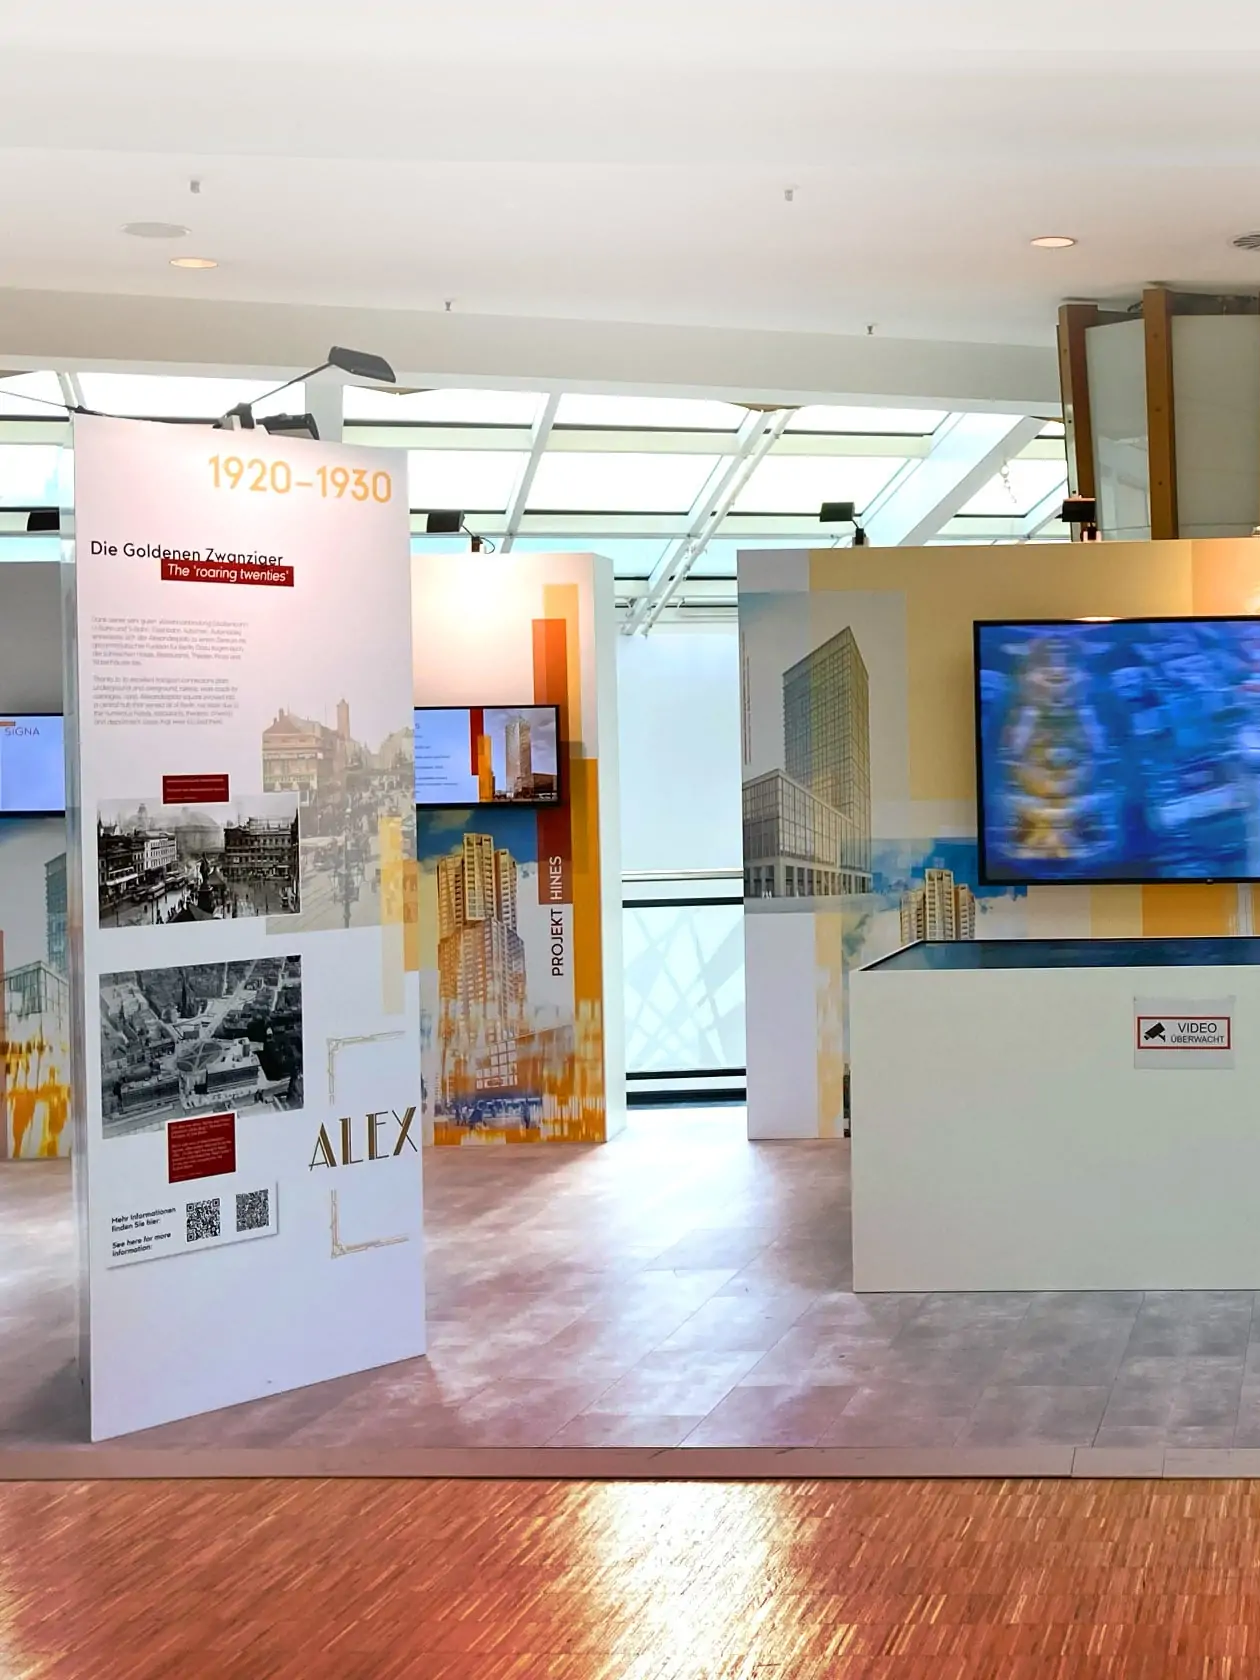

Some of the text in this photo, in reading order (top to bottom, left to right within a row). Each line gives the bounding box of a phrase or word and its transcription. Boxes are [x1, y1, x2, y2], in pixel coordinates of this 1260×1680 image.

[208, 454, 392, 503] 1920–1930
[90, 540, 284, 567] Die Goldenen Zwanziger
[167, 563, 190, 577] The
[549, 856, 564, 977] PROJEKT HINES
[1178, 1022, 1218, 1034] VIDEO
[1170, 1033, 1225, 1043] ÜBERWACHT
[308, 1106, 418, 1172] ALEX
[111, 1216, 129, 1224] Mehr
[111, 1224, 133, 1232] finden
[134, 1220, 145, 1228] Sie
[112, 1232, 171, 1249] See here for more
